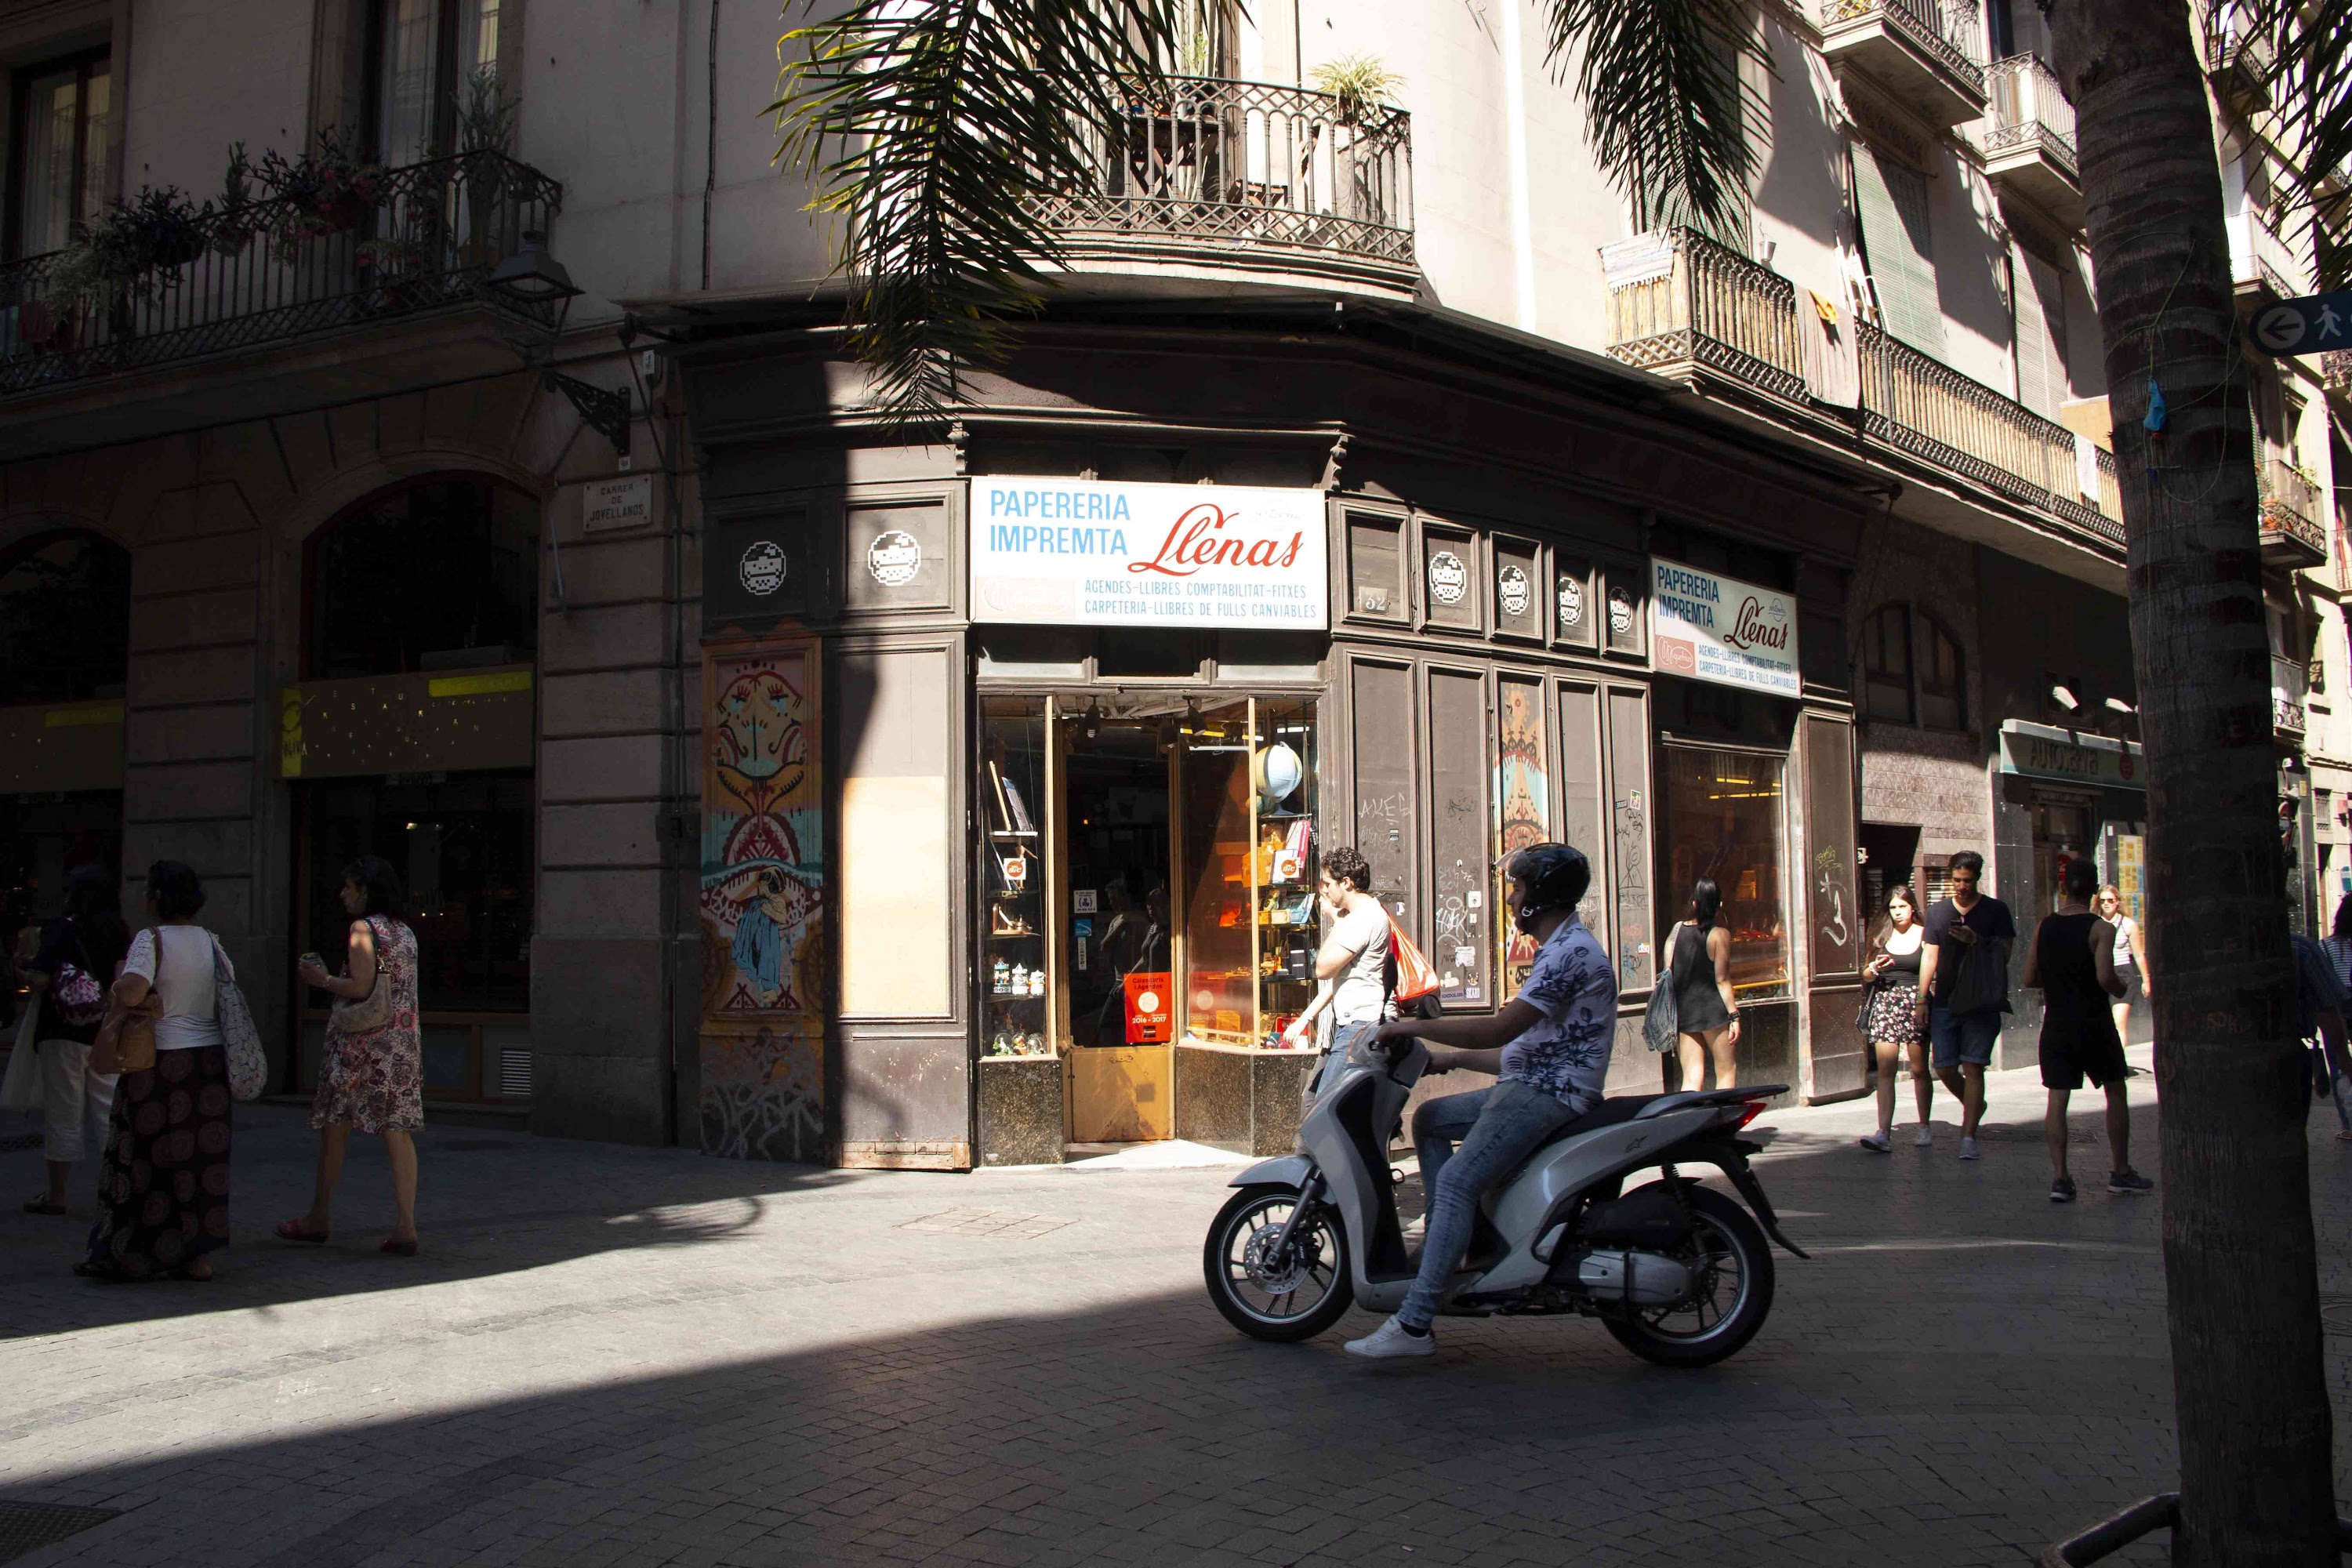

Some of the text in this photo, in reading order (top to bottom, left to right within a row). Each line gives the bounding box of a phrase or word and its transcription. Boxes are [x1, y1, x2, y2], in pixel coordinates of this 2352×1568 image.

[601, 484, 633, 495] CARRER
[612, 495, 622, 504] DE
[590, 504, 644, 521] JOVELLANOS
[990, 490, 1131, 521] PAPERERIA
[990, 524, 1127, 555] IMPREMTA
[1127, 503, 1303, 576] Llenas
[1085, 579, 1307, 599] AGENDES-LLIBRES COMPTABILITAT-FITXES
[1657, 565, 1720, 603] PAPERERIA
[1085, 600, 1317, 618] CARPETERIA-LLIBRES DE FULLS CANVIABLES
[1658, 593, 1715, 628] IMPREMTA
[1723, 596, 1788, 650] Llenas
[1698, 644, 1740, 662] AGENDES-LLIBRES
[1699, 660, 1797, 690] CARPETERIA-LLIBRES DE FULLS CANVIABLES
